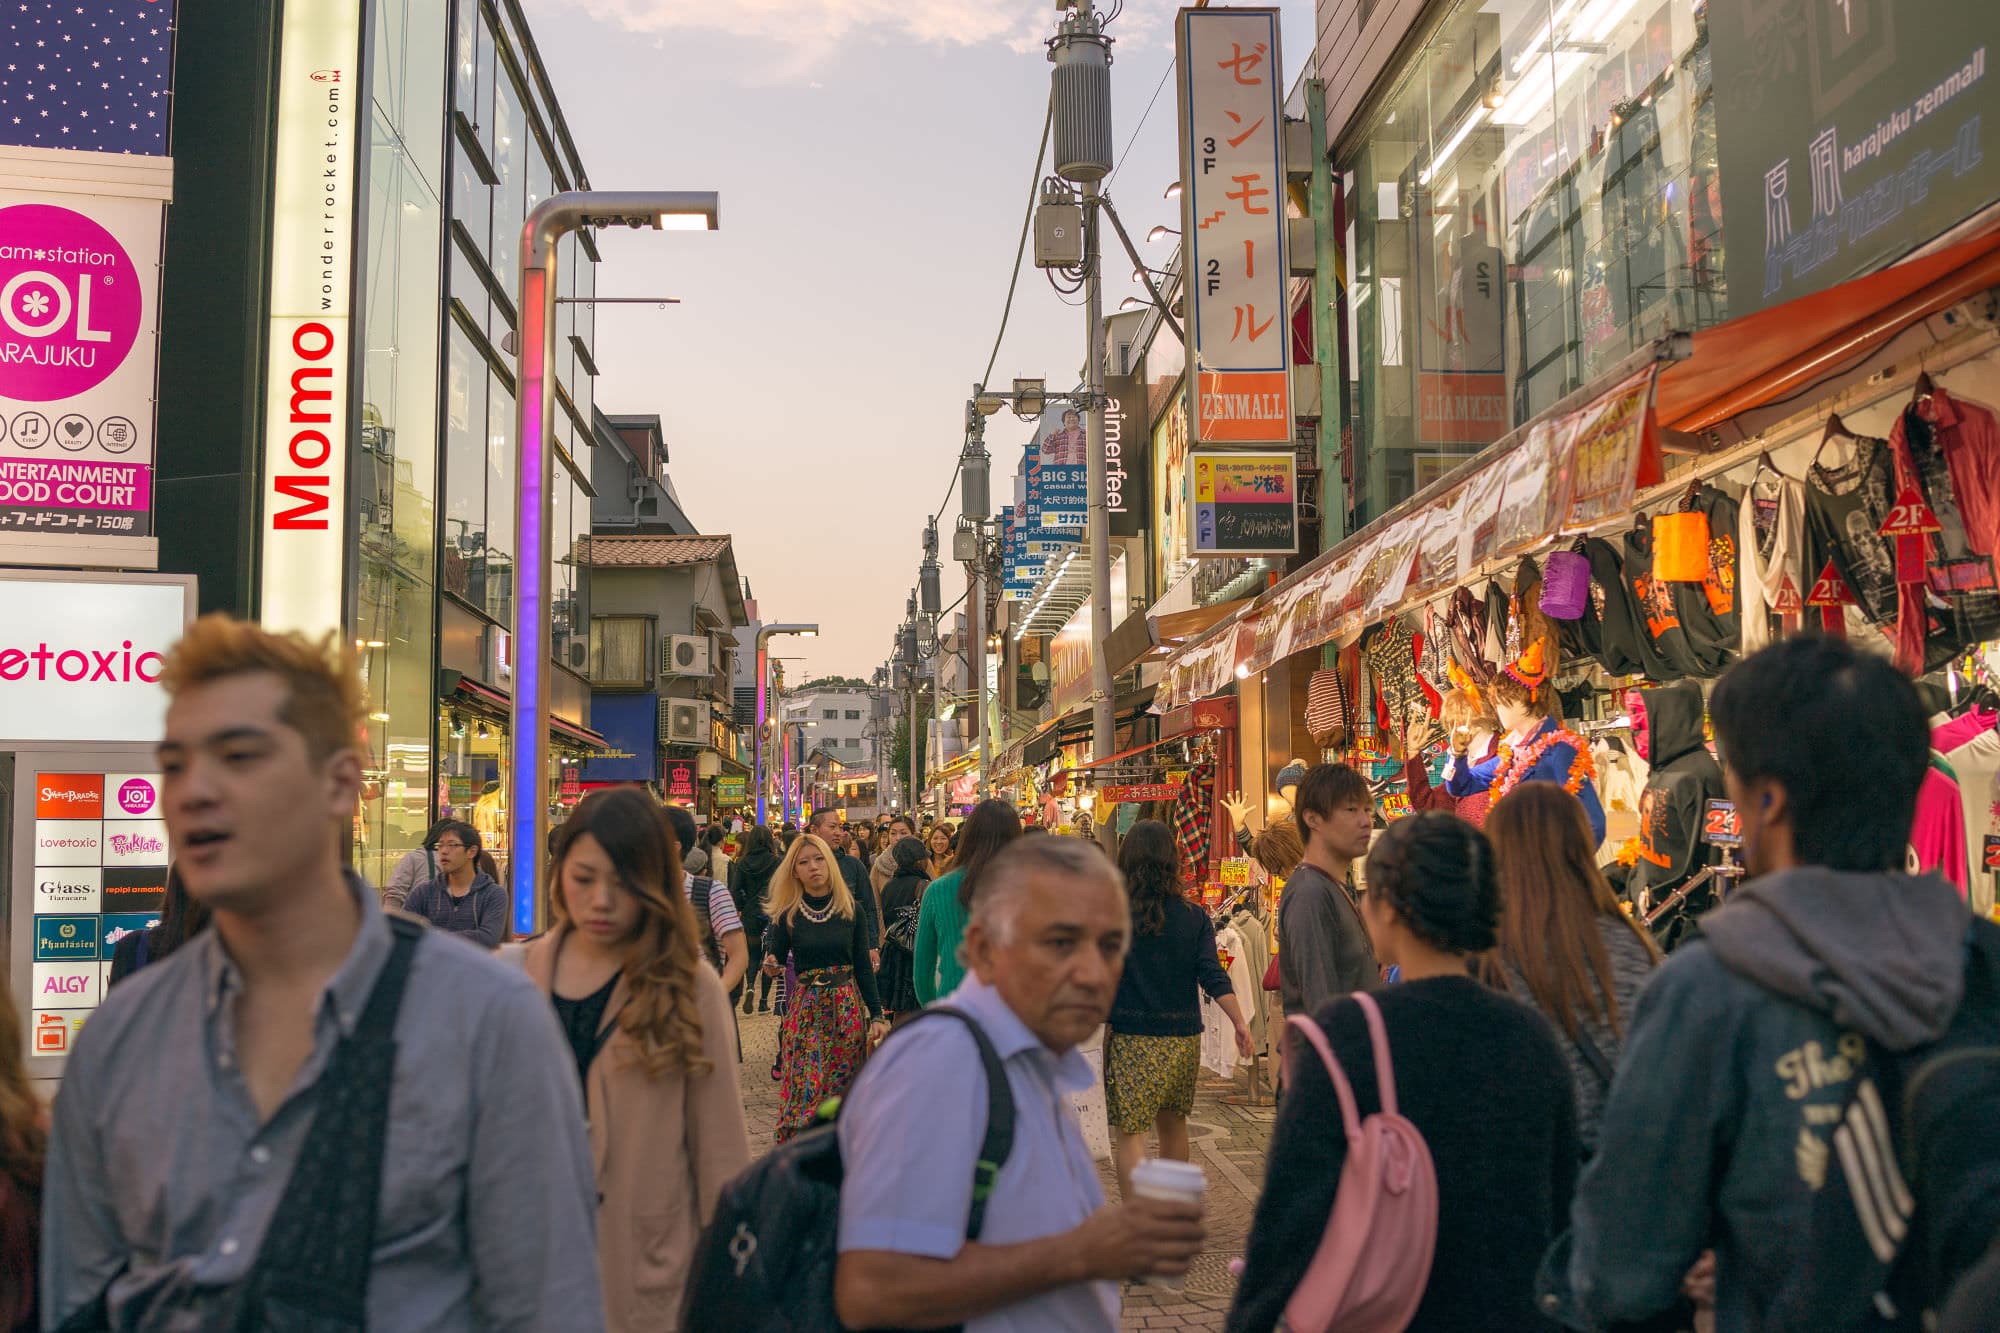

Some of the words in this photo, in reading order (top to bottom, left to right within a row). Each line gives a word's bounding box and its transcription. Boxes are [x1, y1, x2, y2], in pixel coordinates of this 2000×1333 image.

[1844, 108, 1912, 173] harajuku
[1914, 47, 1986, 123] zenmall
[1202, 137, 1216, 175] 3F
[320, 87, 340, 310] wonderrocket.com
[1217, 42, 1275, 345] ゼンモール
[1206, 258, 1221, 297] 2F
[1202, 393, 1285, 421] ZENMALL
[273, 322, 335, 530] Momo
[1104, 398, 1128, 512] aimerfeel
[1042, 471, 1067, 482] BIG
[56, 484, 136, 506] COURT
[1889, 503, 1926, 528] 2F
[1816, 579, 1843, 598] 2F
[123, 789, 151, 804] JOL
[105, 886, 130, 895] repipi
[43, 975, 90, 994] ALGY
